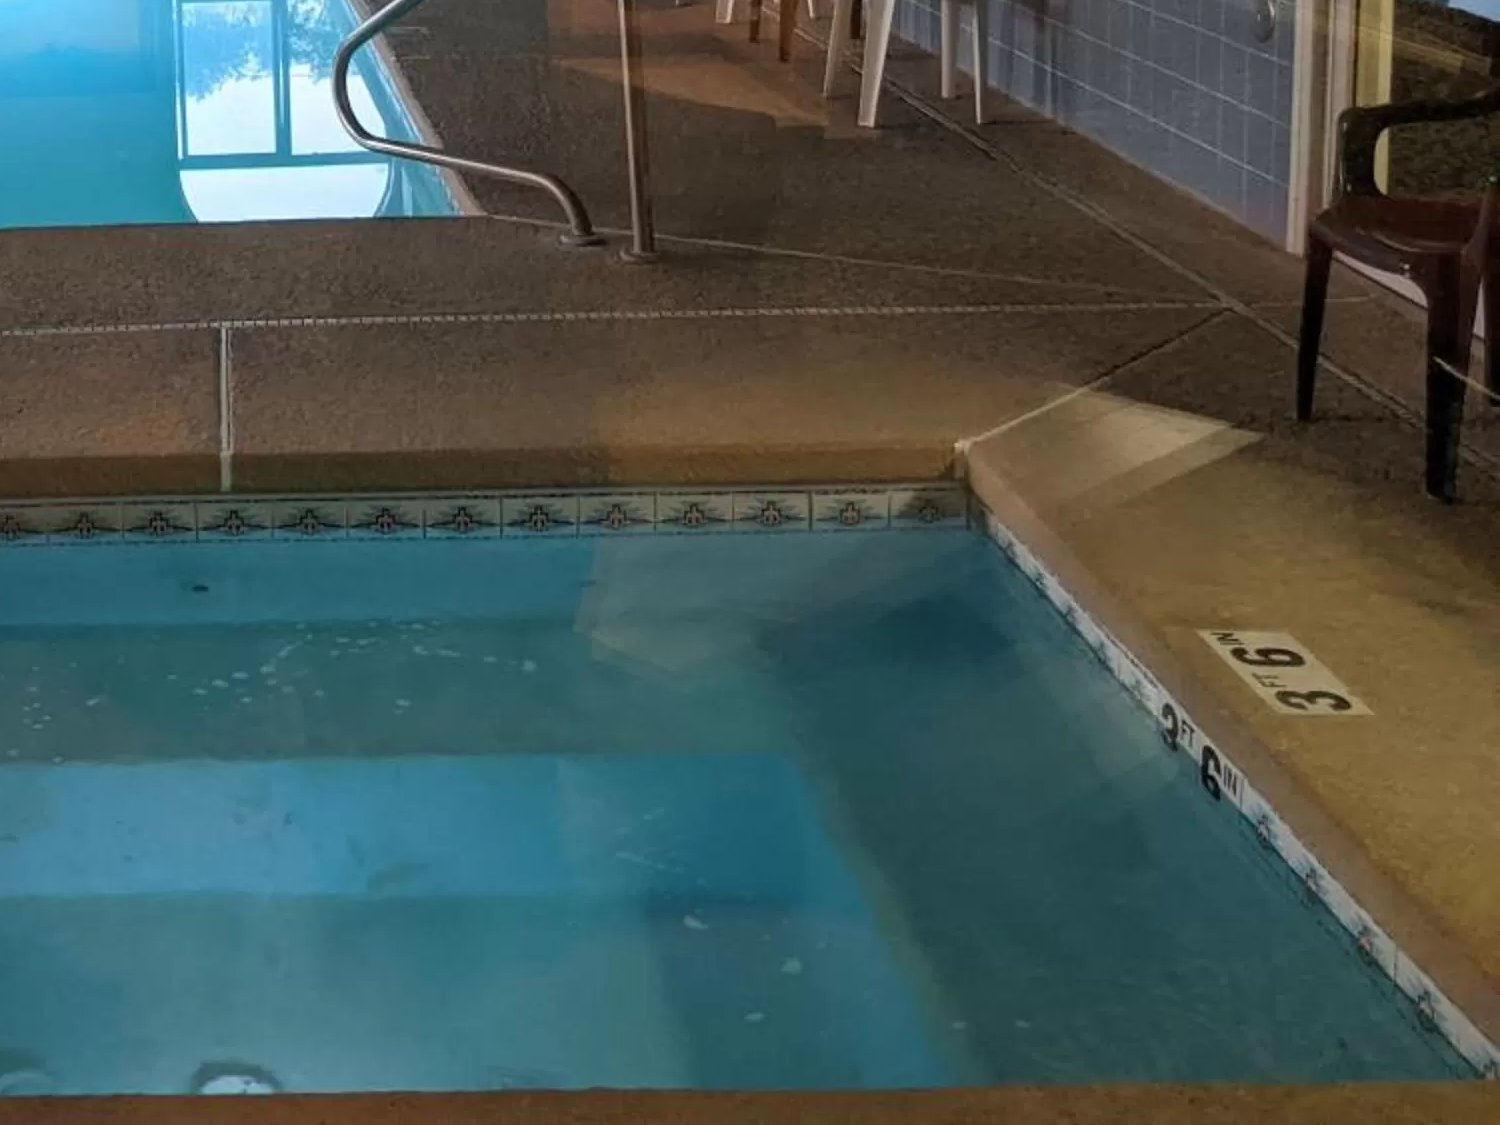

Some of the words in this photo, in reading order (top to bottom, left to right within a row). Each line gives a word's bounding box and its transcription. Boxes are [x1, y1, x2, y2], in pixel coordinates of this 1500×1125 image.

[1274, 690, 1352, 711] 3
[1161, 702, 1179, 752] 3
[1180, 719, 1195, 747] FT
[1201, 744, 1221, 801] 6
